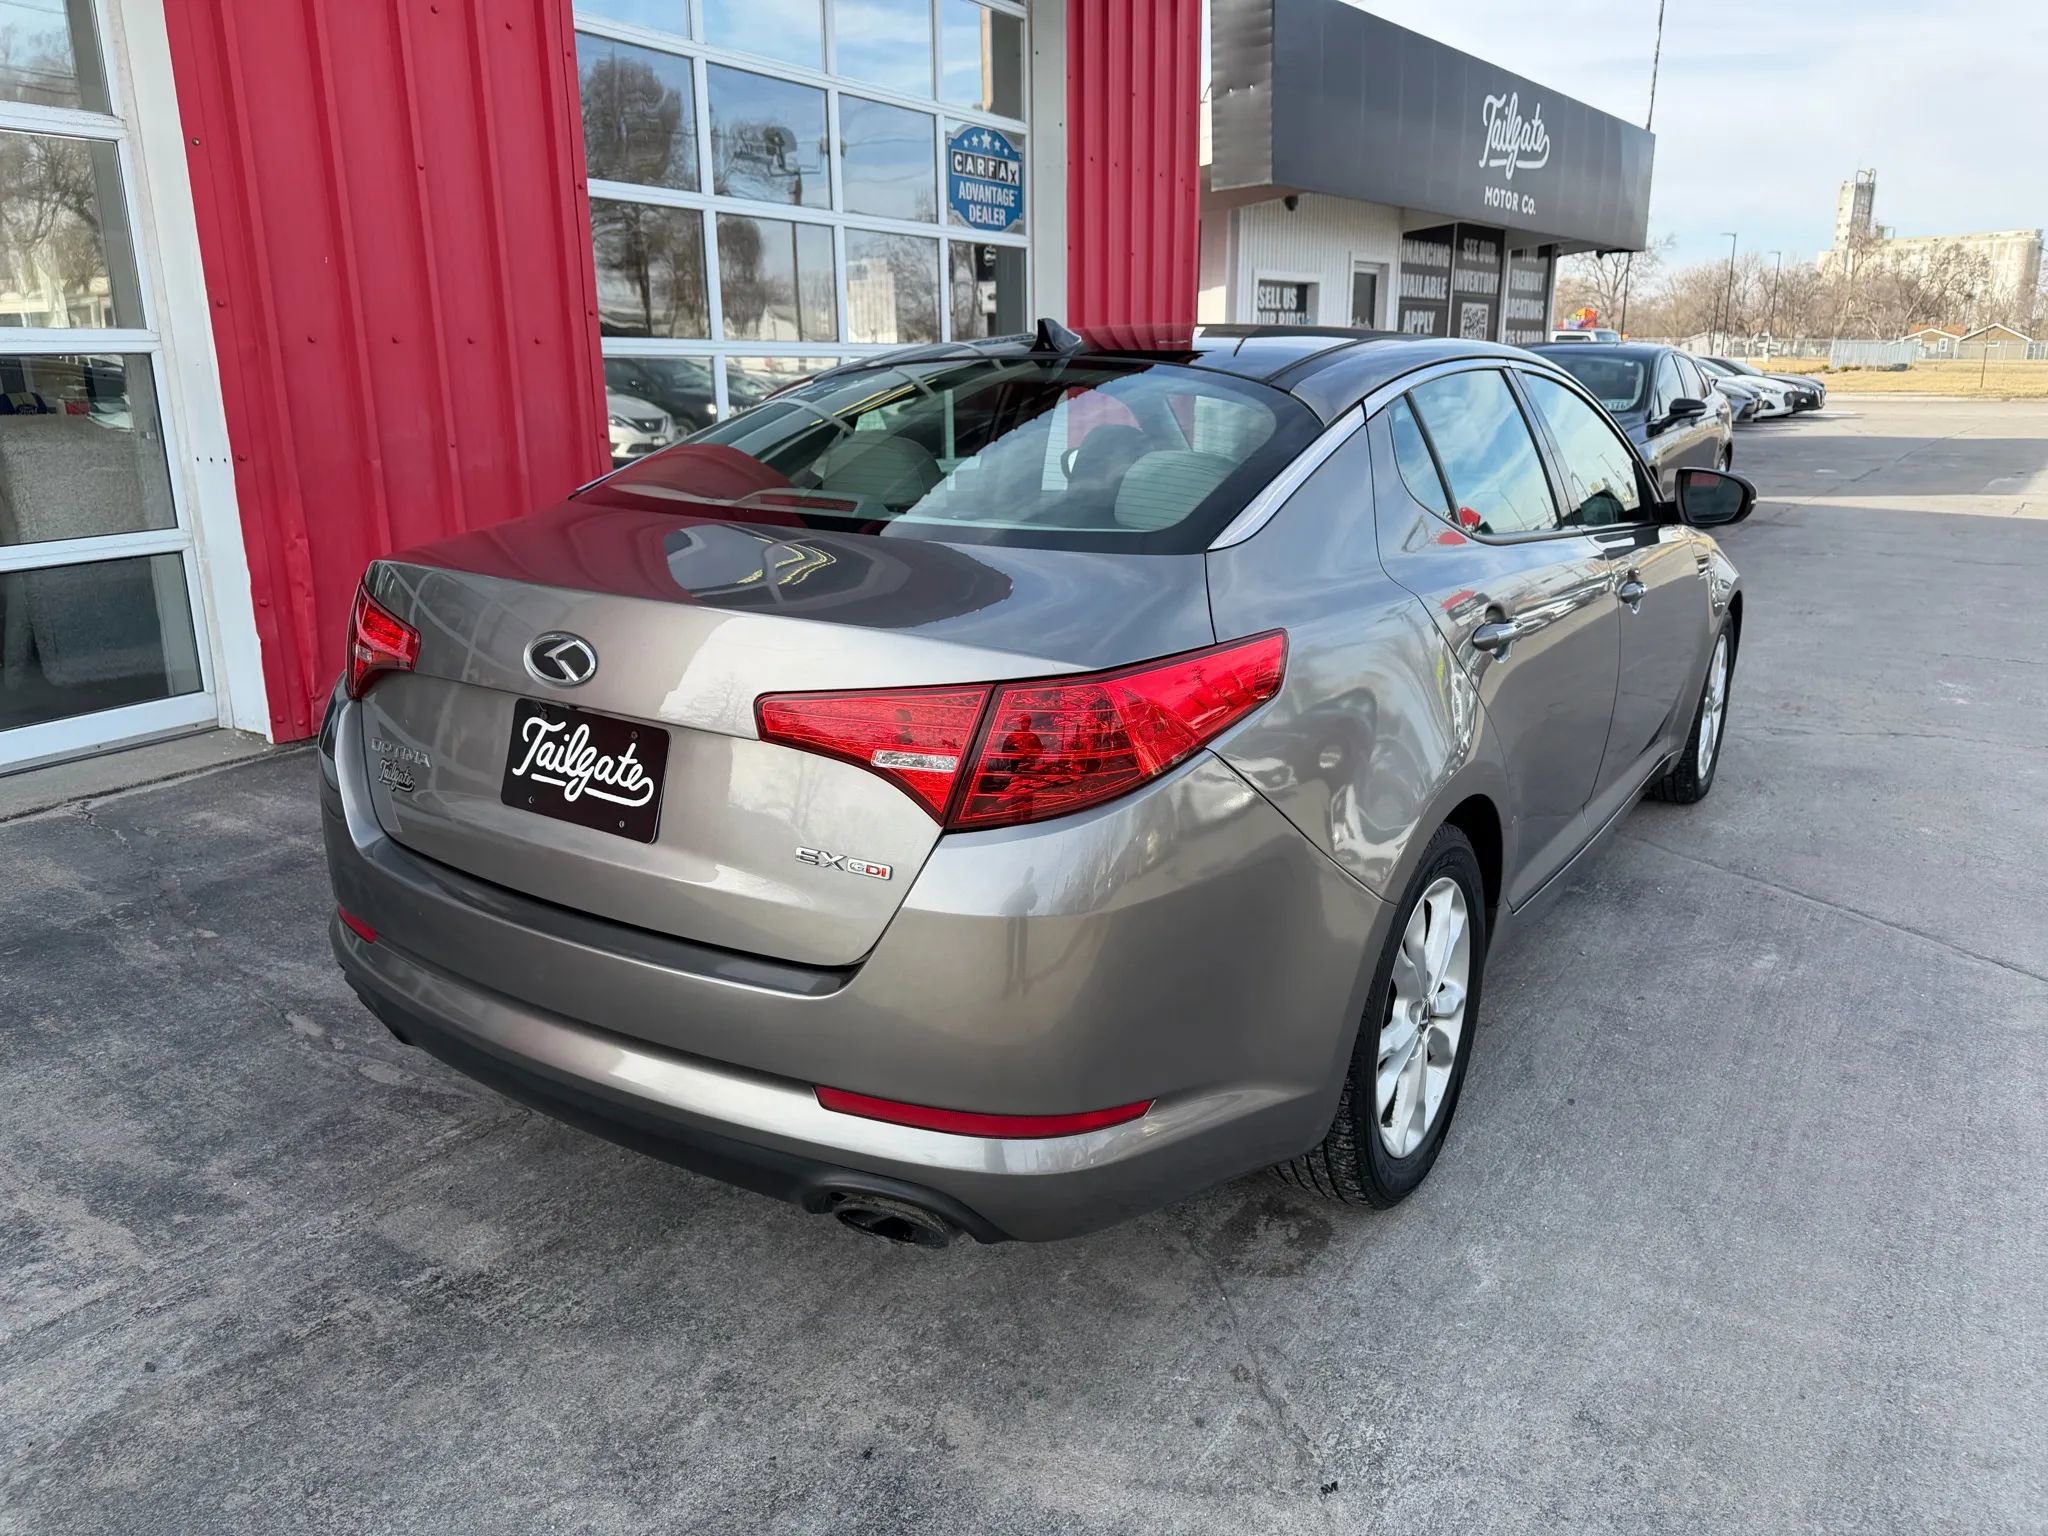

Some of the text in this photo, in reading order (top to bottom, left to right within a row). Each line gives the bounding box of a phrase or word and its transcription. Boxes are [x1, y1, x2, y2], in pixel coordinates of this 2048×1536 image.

[1479, 92, 1550, 180] Tailgate
[953, 153, 1019, 184] CARFAX
[1484, 186, 1519, 212] MOTOR
[968, 203, 1006, 226] DEALER
[1401, 238, 1451, 268] INANCING
[1463, 237, 1479, 261] SEE
[1480, 239, 1496, 264] OUR
[1455, 267, 1500, 294] INVENTORY
[1511, 268, 1544, 292] FREMONT
[1258, 286, 1297, 310] SELL US
[1506, 298, 1544, 320] LOCATIONS
[1403, 309, 1436, 334] APPLY
[371, 737, 431, 767] OPTIMA
[512, 716, 655, 807] Tailgate
[379, 759, 416, 791] Tailgate
